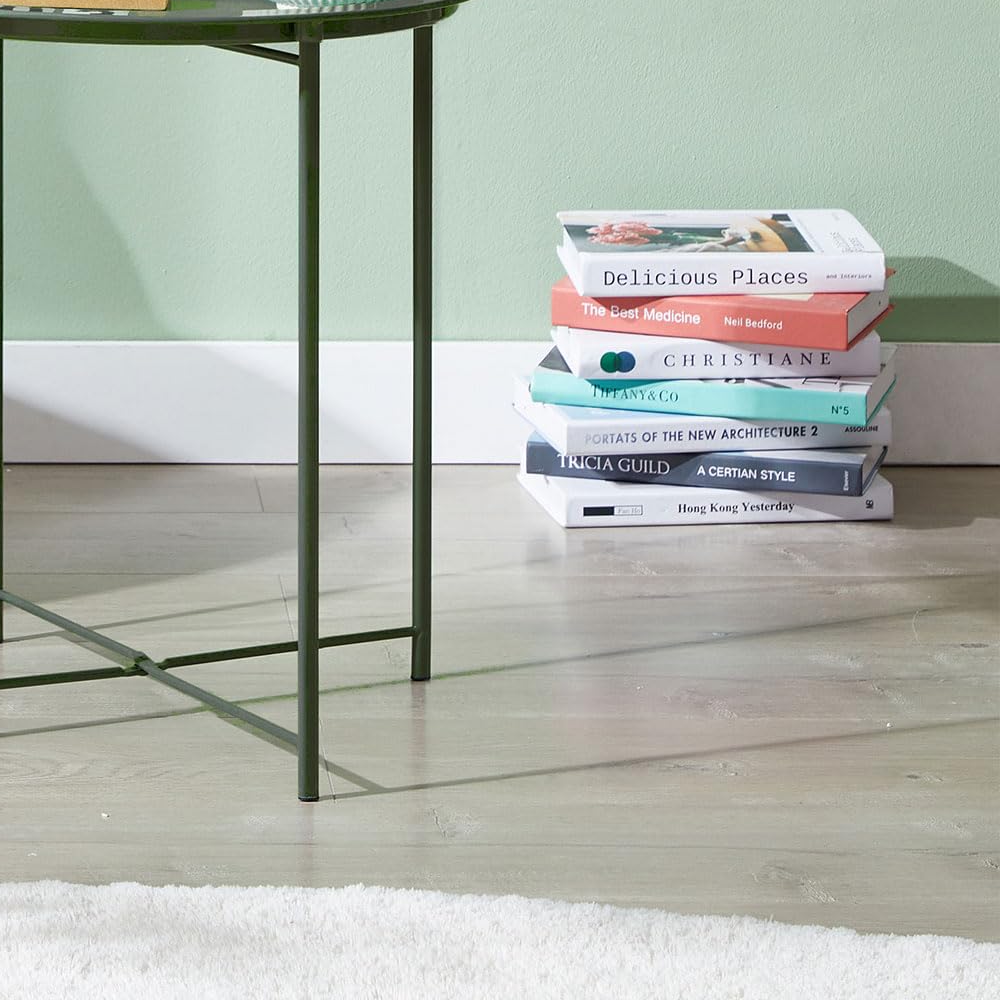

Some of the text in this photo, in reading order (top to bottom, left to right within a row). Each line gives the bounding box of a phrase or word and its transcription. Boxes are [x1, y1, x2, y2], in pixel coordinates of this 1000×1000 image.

[603, 267, 809, 287] Delicious Places
[581, 302, 701, 325] The Best Medicine
[723, 315, 784, 331] Neil Bedford
[663, 351, 832, 368] CHRISTIANE
[585, 425, 819, 445] PORTATS OF THE NEW ARCHITECTURE 2
[844, 424, 879, 433] ASSOULINE
[556, 453, 671, 476] TRICIA GUILD
[696, 464, 797, 483] A CERTIAN STYLE
[677, 501, 796, 515] Hong Kong Yesterday
